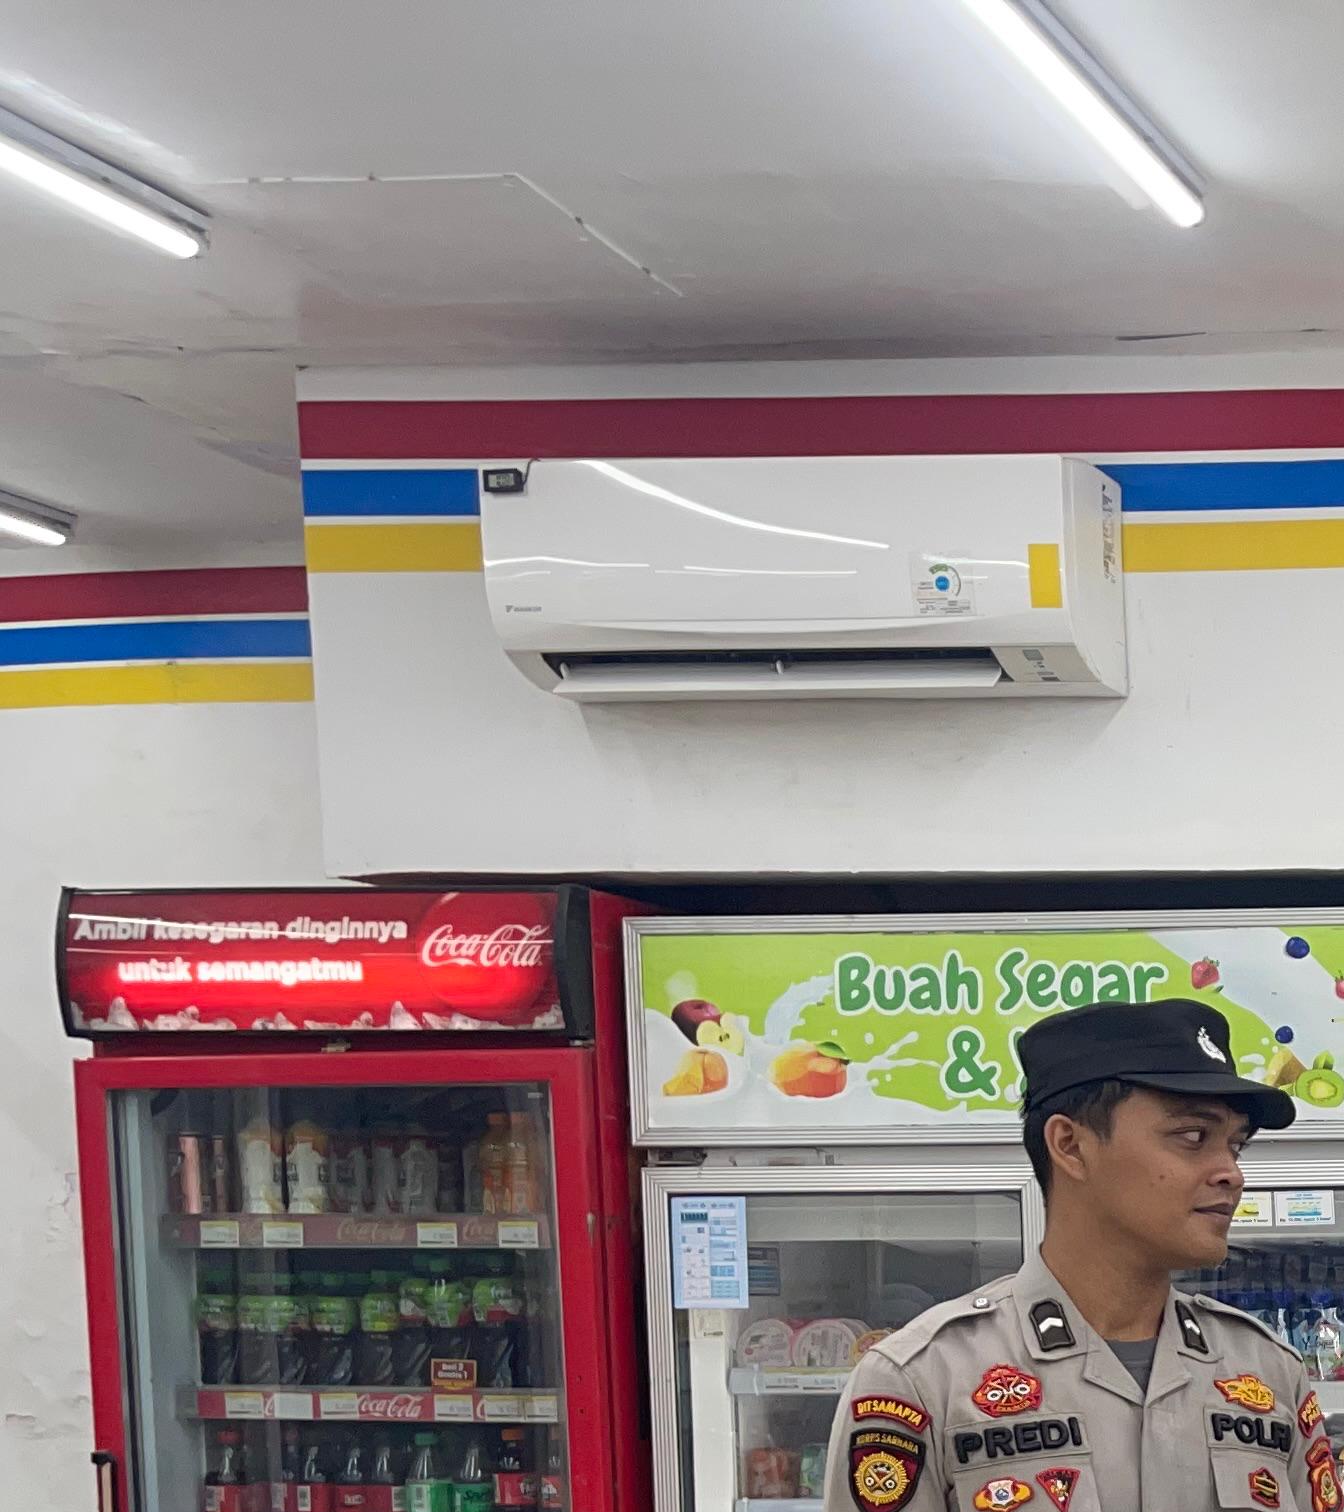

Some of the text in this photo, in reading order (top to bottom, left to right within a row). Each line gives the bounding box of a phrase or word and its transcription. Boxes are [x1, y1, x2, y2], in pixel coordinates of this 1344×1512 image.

[421, 924, 554, 968] Coca-Cola
[118, 957, 364, 987] untuk semangatmu
[838, 952, 980, 1013] Buah
[954, 1417, 1082, 1464] PREDI
